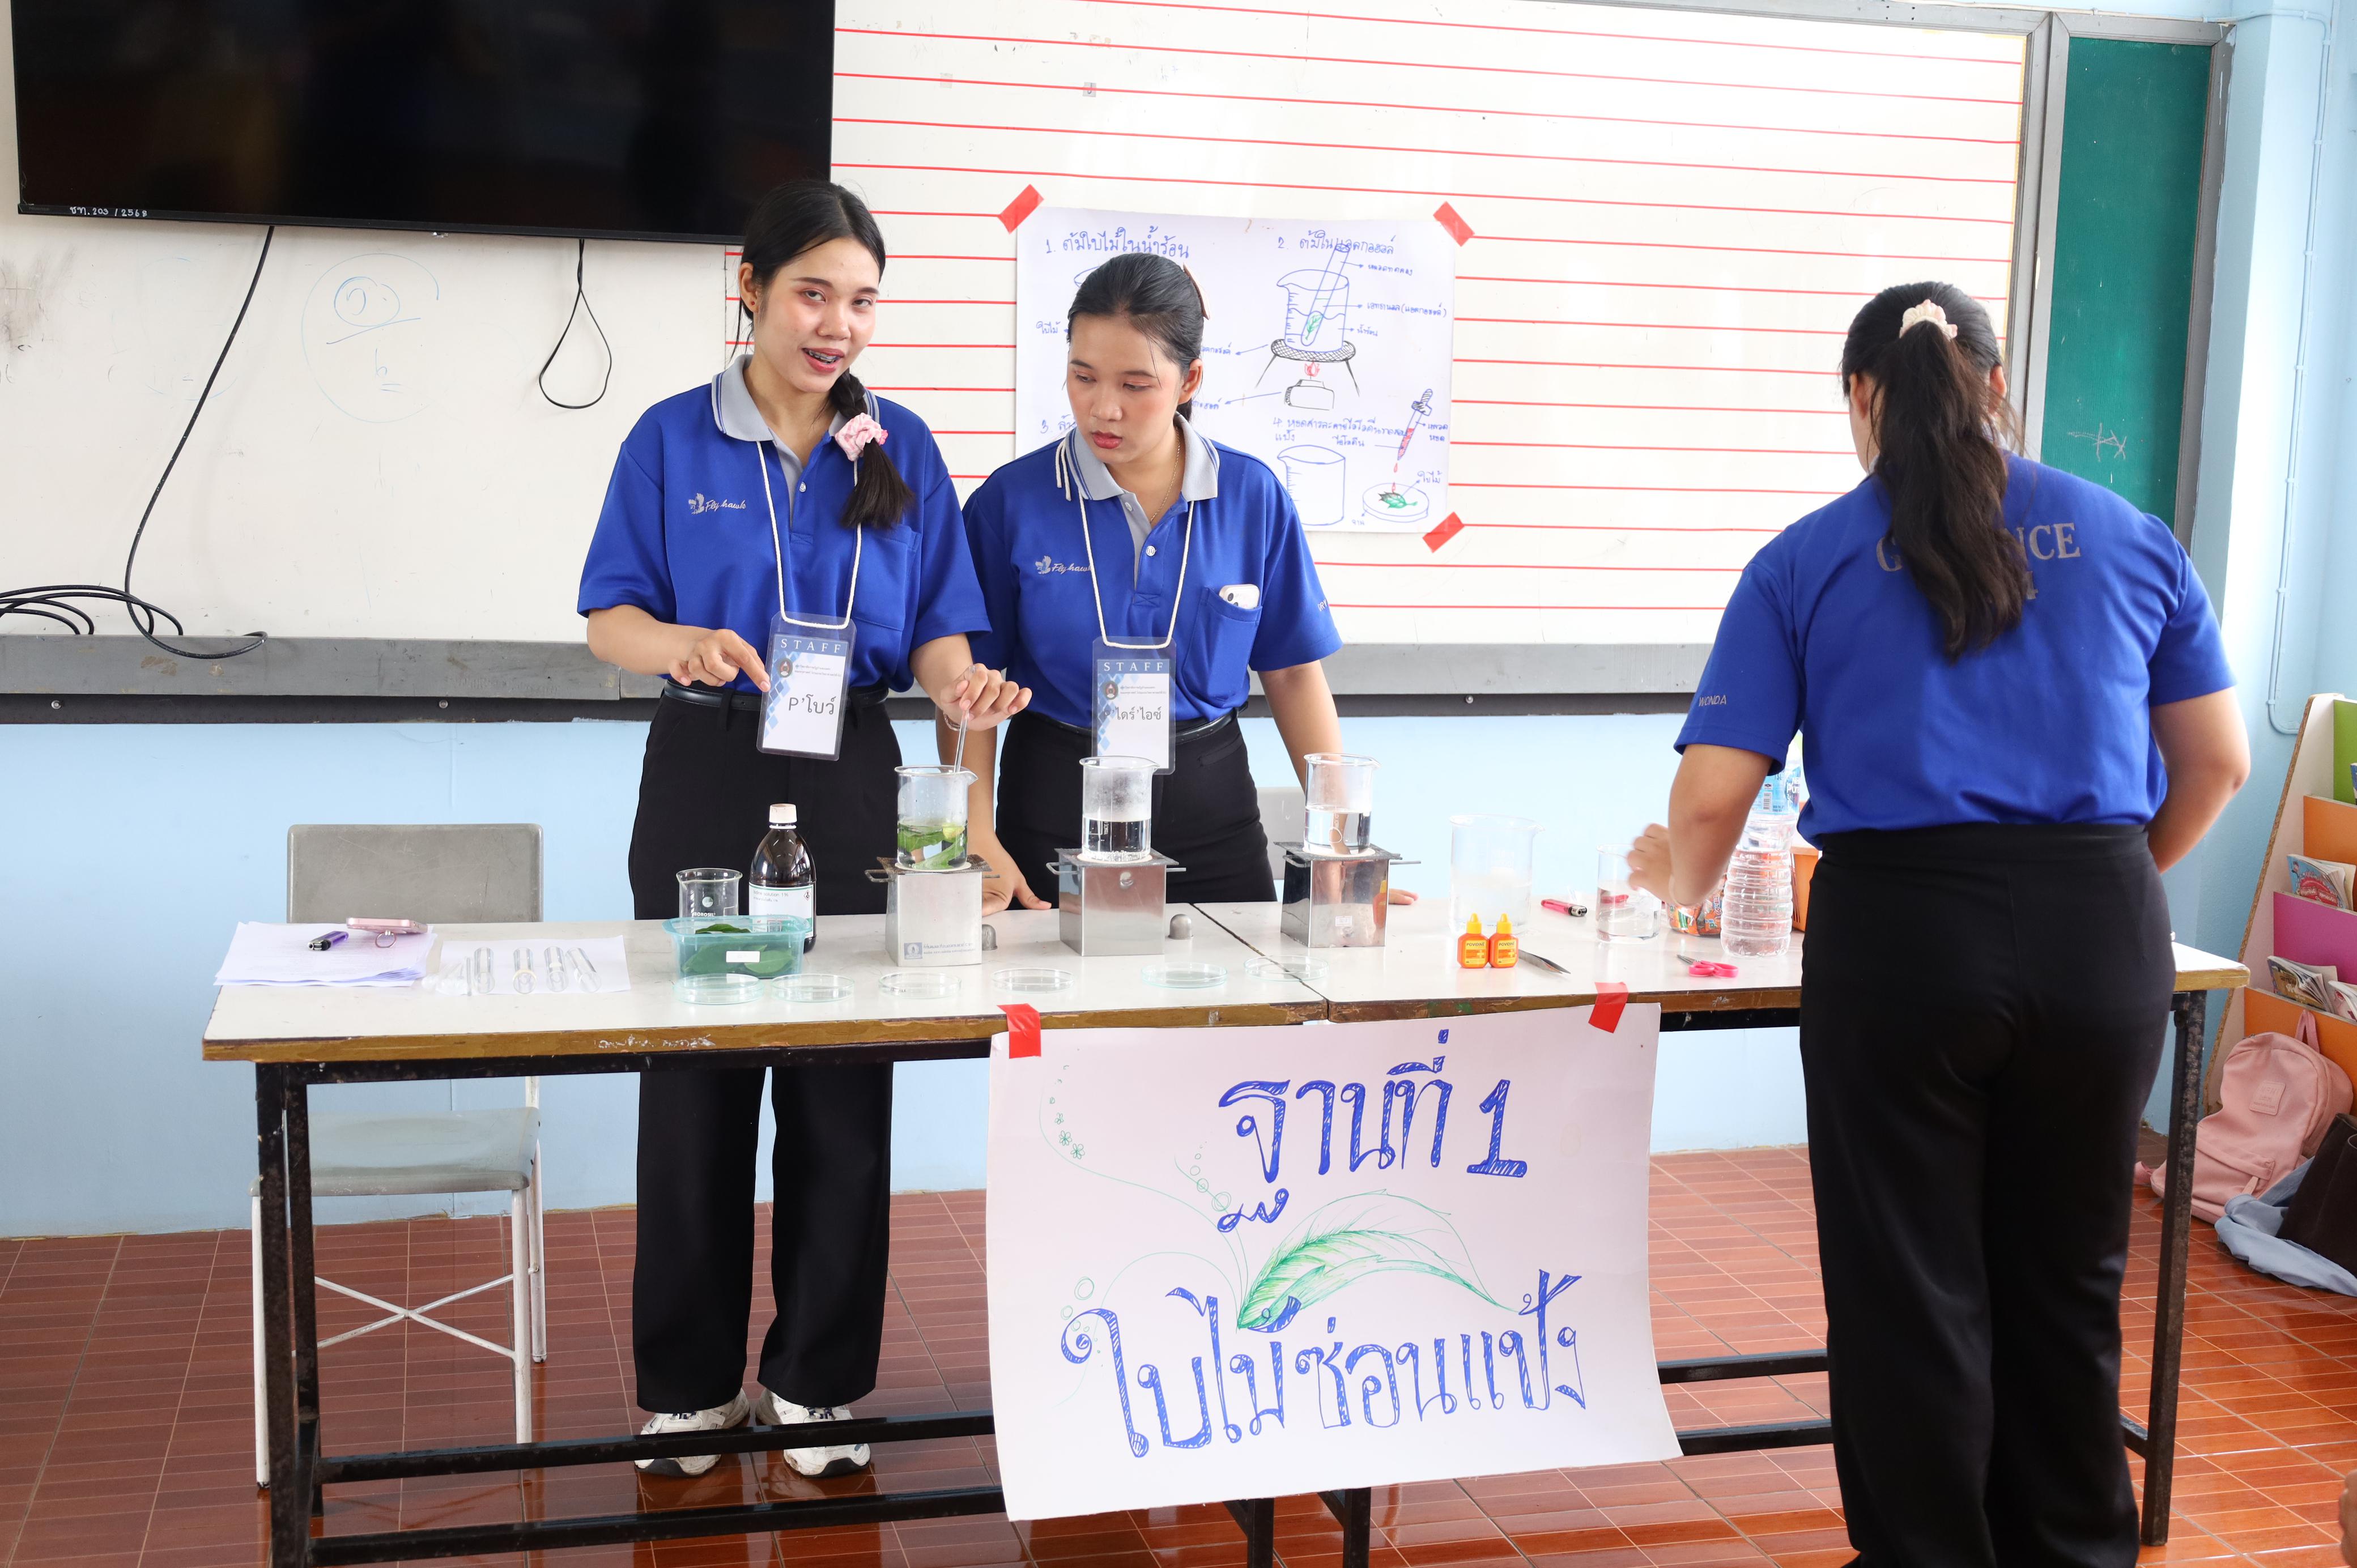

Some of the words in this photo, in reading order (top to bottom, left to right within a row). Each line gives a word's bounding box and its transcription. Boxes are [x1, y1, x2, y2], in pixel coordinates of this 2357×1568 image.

[1036, 321, 1061, 334] ใบไม้
[1417, 470, 1443, 484] ใบไม้
[781, 638, 841, 653] STAFF
[1104, 662, 1163, 671] STAFF
[1218, 1029, 1453, 1232] ฐานที่
[1466, 1079, 1528, 1178] 1
[1061, 1268, 1587, 1458] ใบไม้ซ่อนแป้ง
